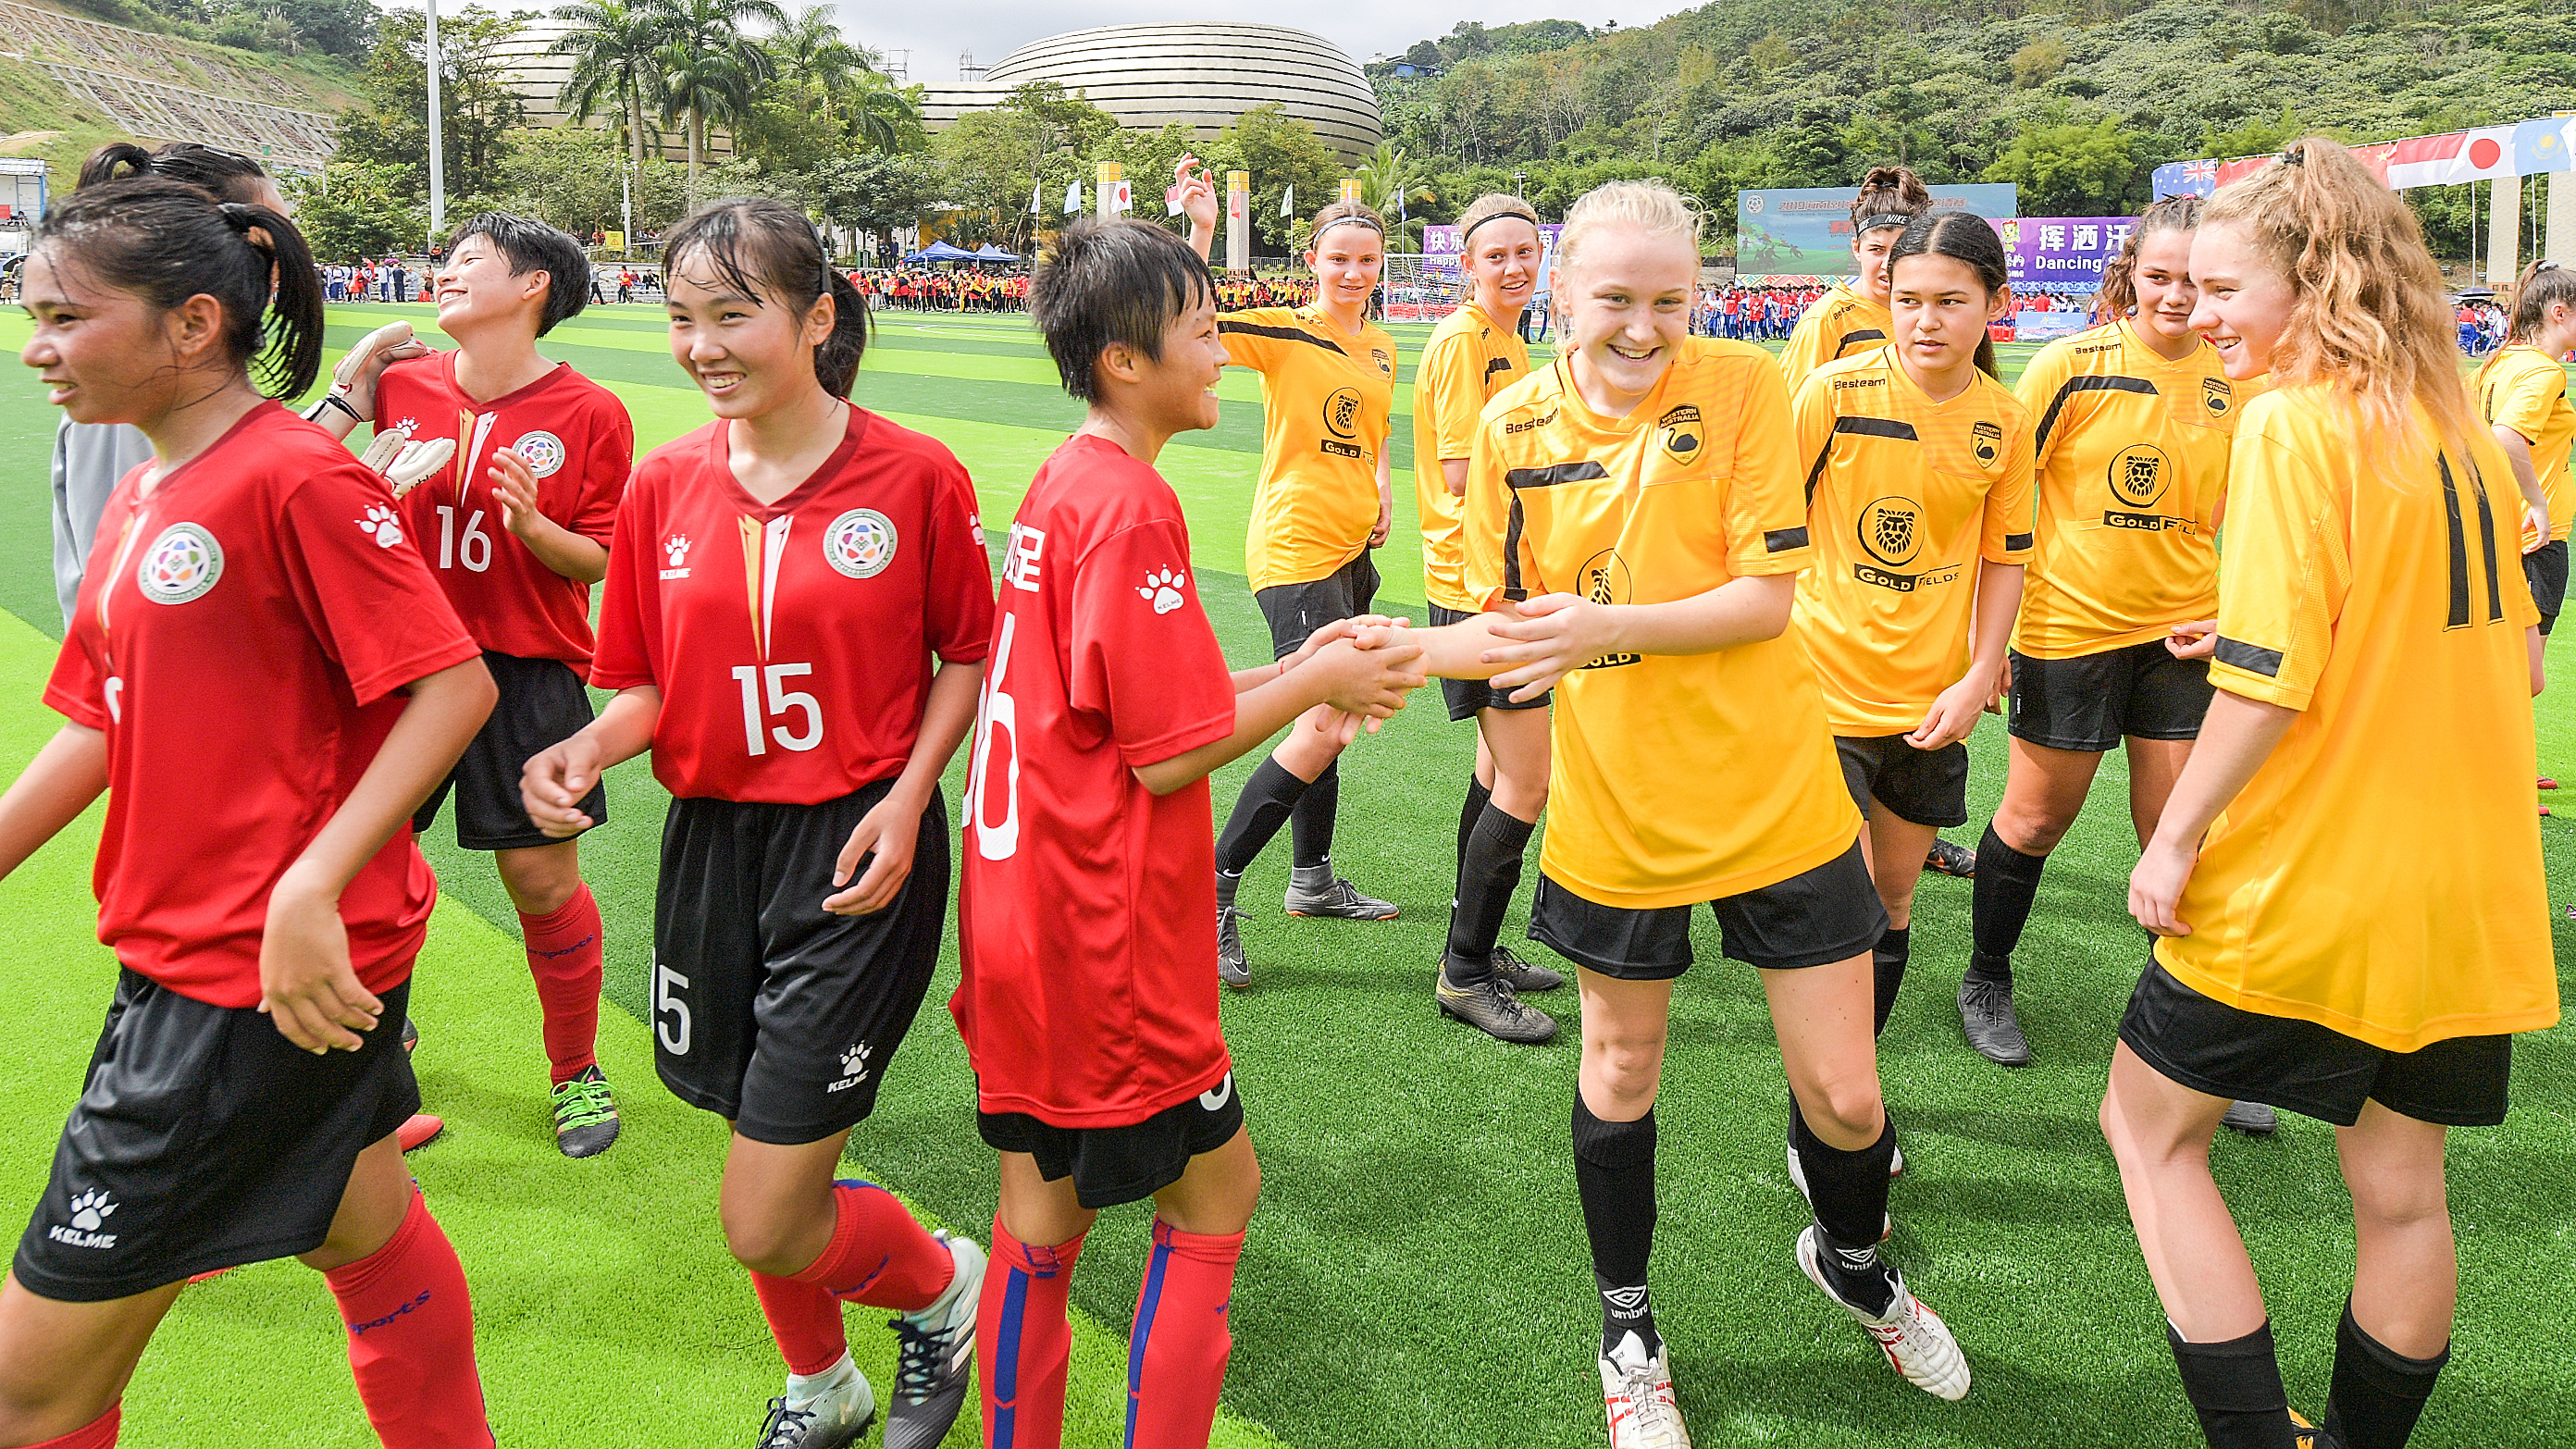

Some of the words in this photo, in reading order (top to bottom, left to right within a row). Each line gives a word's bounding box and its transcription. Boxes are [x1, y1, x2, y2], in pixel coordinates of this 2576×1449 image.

[1885, 215, 1908, 224] NIKE
[1430, 230, 1466, 252] 快乐
[1430, 256, 1461, 267] Happy
[2036, 255, 2102, 273] Dancing
[2075, 343, 2122, 354] Besteam
[1834, 378, 1886, 390] Besteam
[1506, 408, 1559, 434] Besteam
[1660, 414, 1700, 428] AUSTRALIA
[1662, 408, 1697, 423] WESTERN
[1325, 441, 1357, 457] GOLD
[2109, 514, 2159, 530] GOLD
[437, 505, 491, 572] 16
[2434, 440, 2506, 632] 11
[660, 567, 691, 580] KELME
[1858, 567, 1912, 591] GOLD
[1158, 598, 1182, 611] KELME
[1590, 652, 1632, 667] OLD
[730, 662, 824, 756] 15
[48, 1224, 118, 1249] KELME
[1611, 1304, 1648, 1320] umbro
